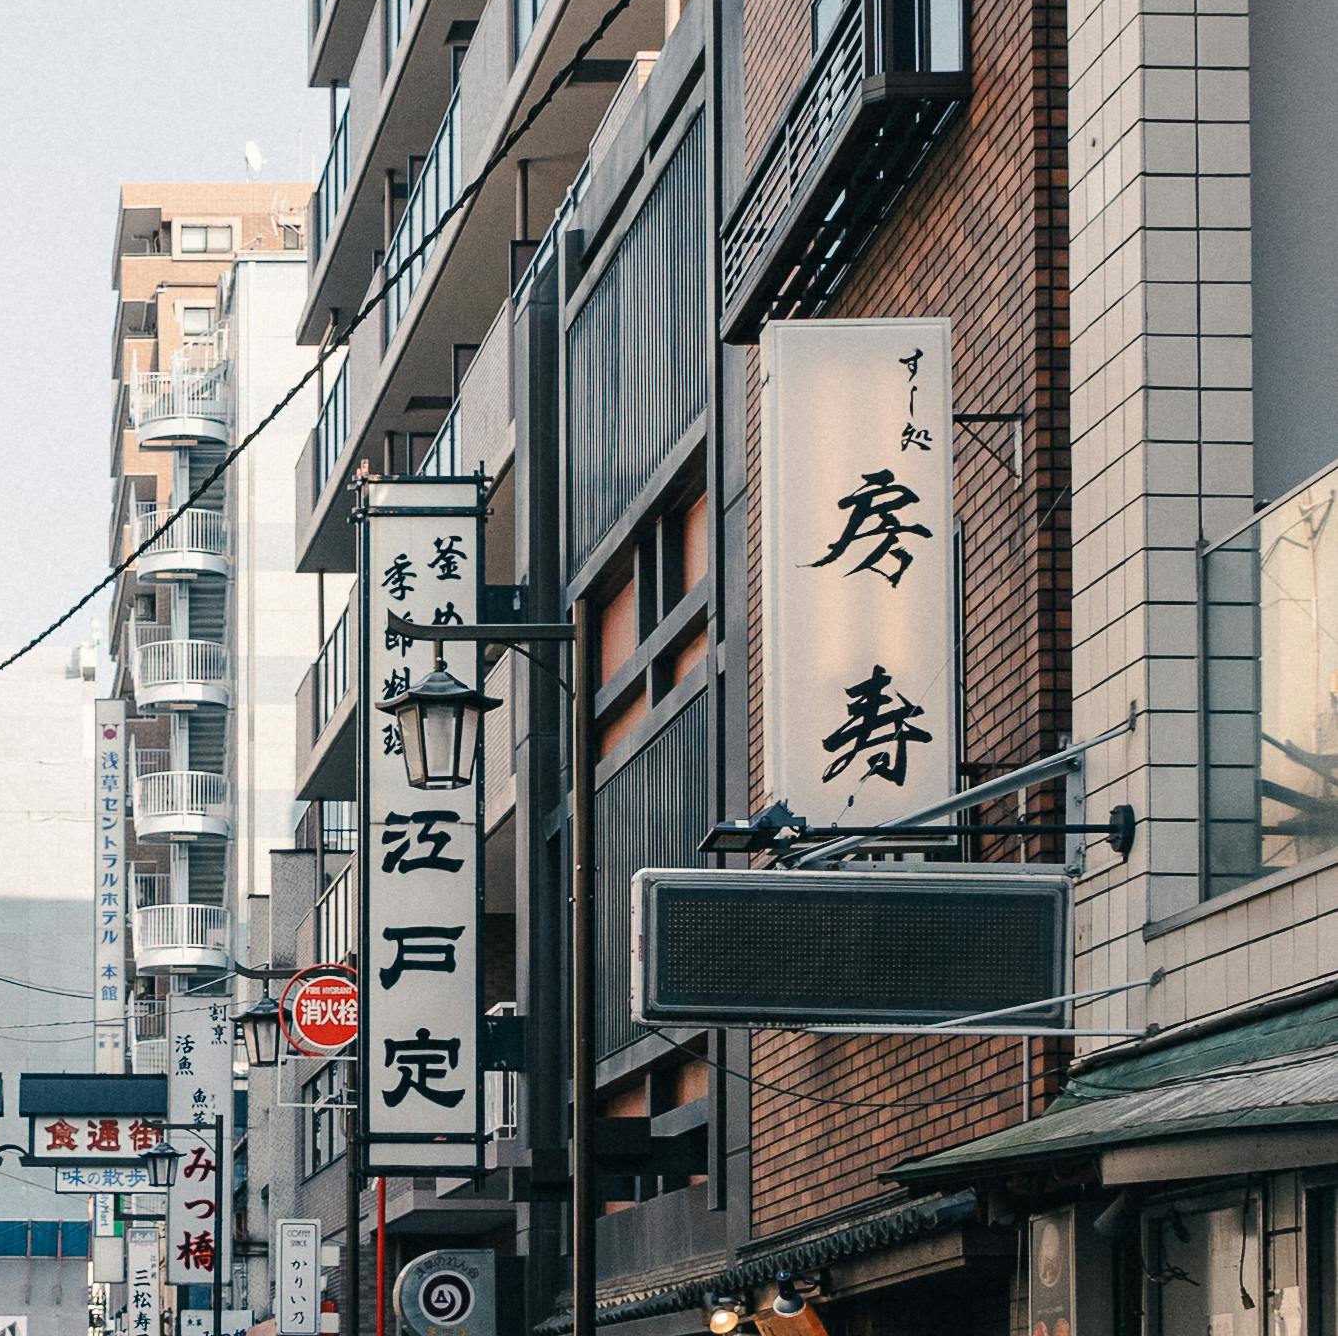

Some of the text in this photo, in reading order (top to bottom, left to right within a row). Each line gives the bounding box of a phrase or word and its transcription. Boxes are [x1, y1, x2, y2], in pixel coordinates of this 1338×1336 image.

[898, 346, 933, 452] すし処
[101, 750, 120, 945] 浅草セントラルホテル
[378, 809, 467, 1109] 江戸定
[100, 963, 119, 1003] 本館
[305, 986, 352, 995] FIRE HYDRANT
[300, 998, 359, 1026] 消火栓
[175, 1034, 196, 1076] 活魚
[44, 1117, 165, 1152] 食通街
[62, 1166, 148, 1187] 味の散歩
[176, 1146, 216, 1273] みつ橋
